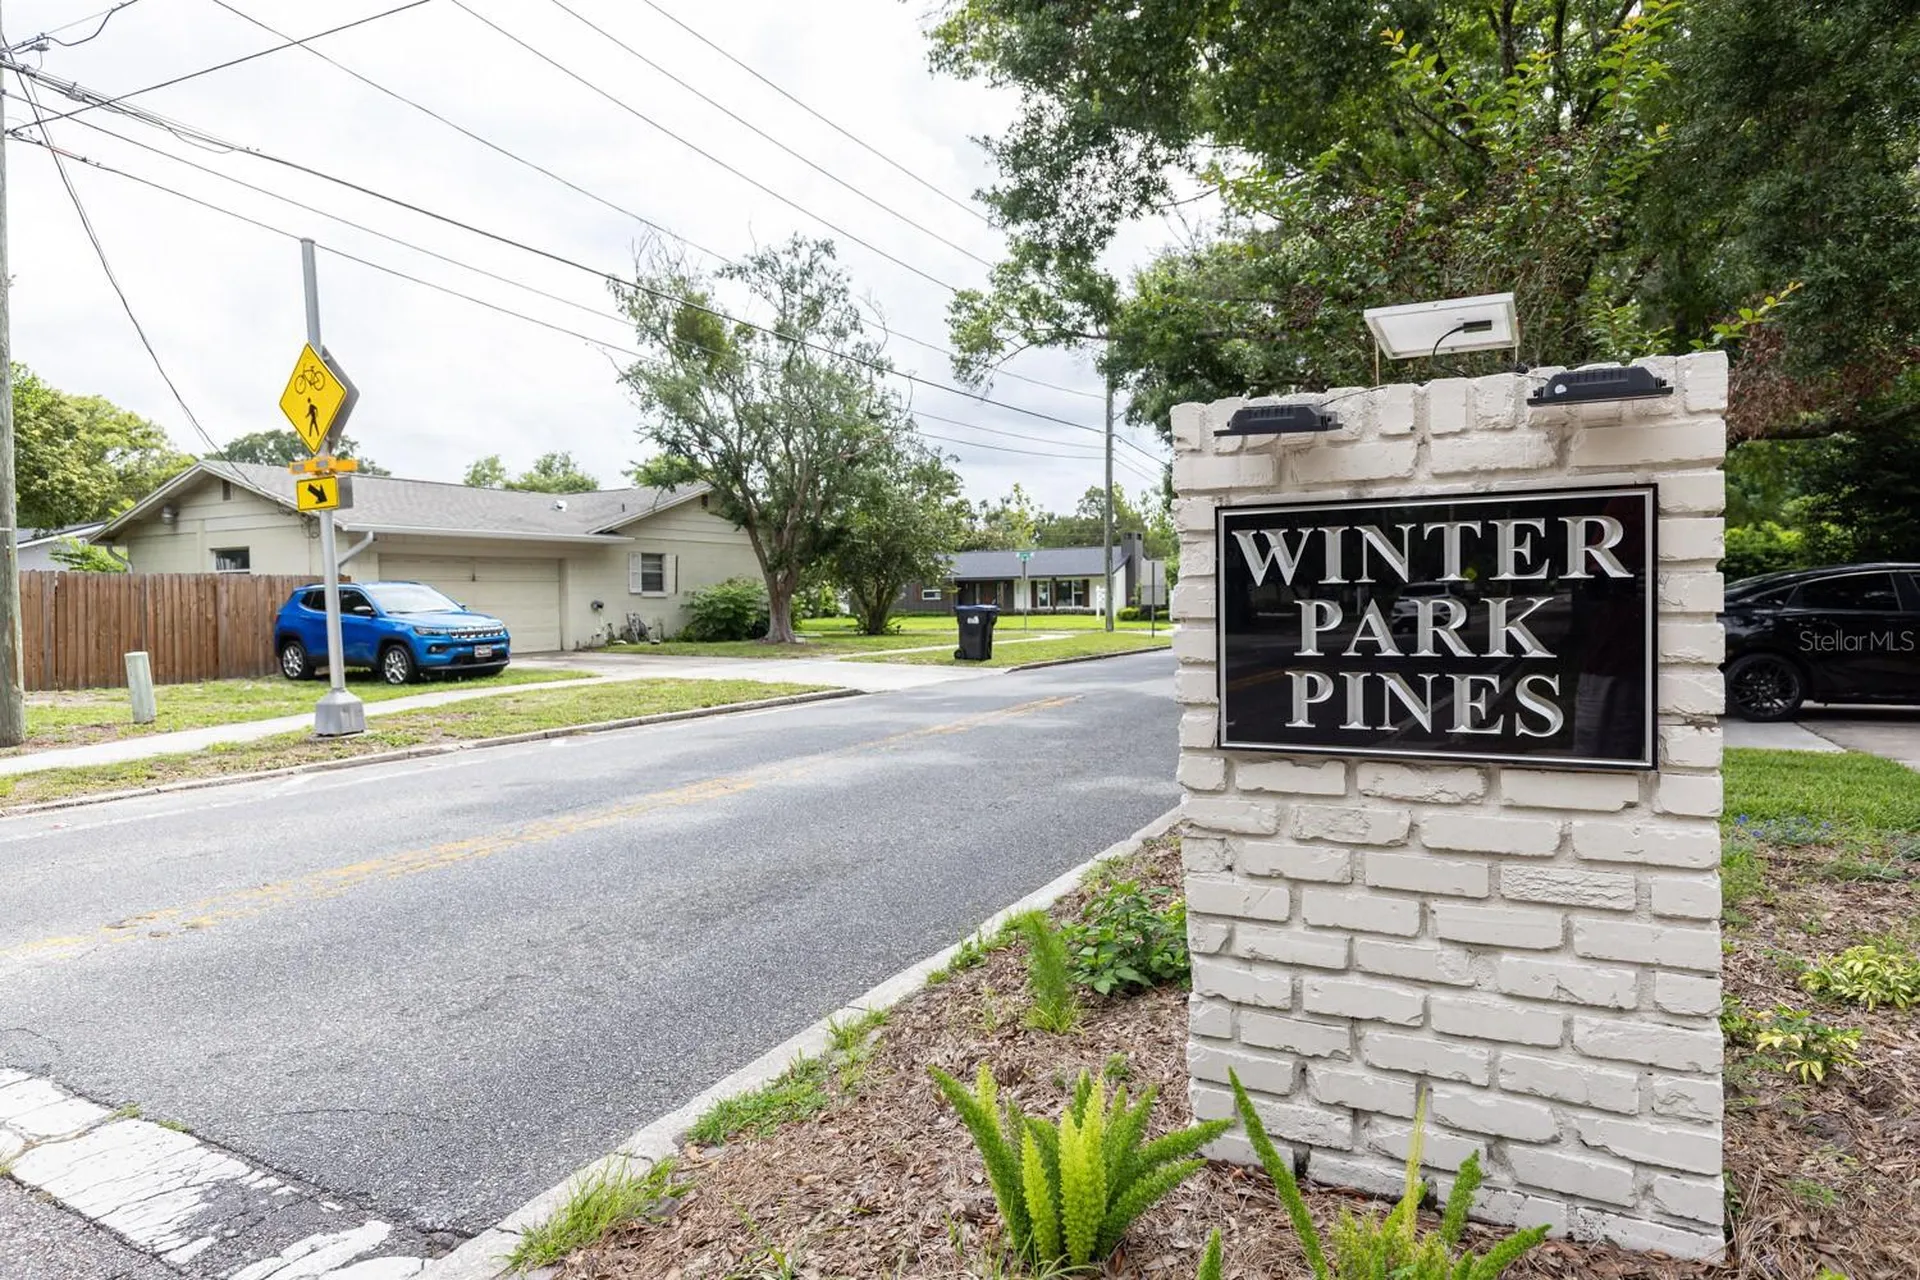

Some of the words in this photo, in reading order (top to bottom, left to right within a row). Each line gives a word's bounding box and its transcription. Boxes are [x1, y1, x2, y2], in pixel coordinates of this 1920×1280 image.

[1231, 515, 1635, 587] WINTER
[1293, 597, 1557, 658] PARK
[1285, 671, 1564, 737] PINES
